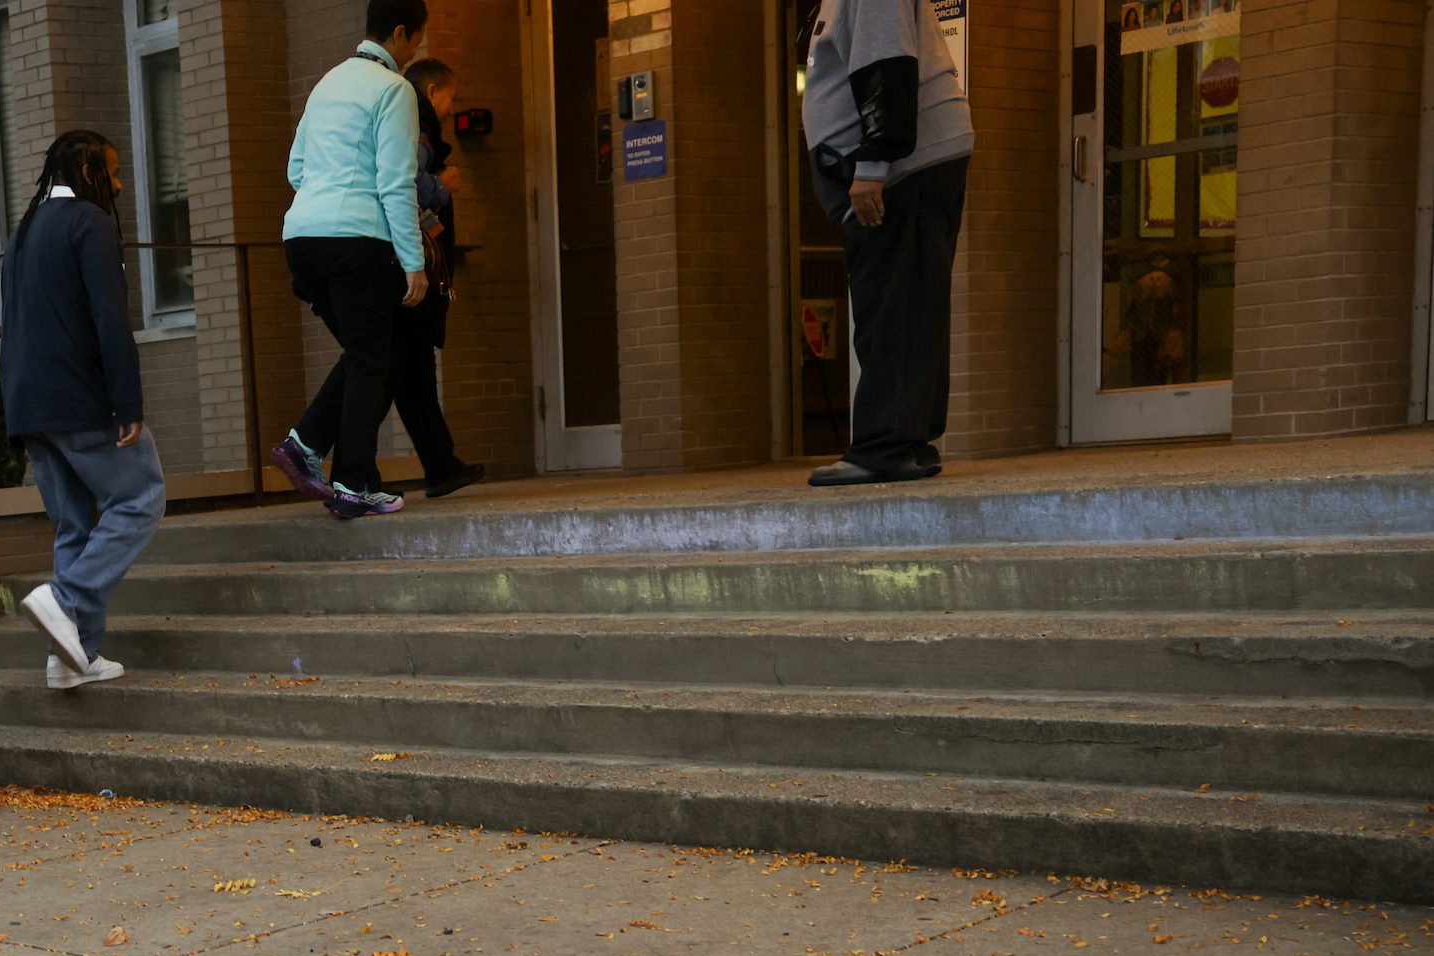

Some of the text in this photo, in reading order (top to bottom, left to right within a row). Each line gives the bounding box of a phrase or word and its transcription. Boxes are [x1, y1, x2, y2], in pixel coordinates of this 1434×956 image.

[626, 134, 663, 148] INTERCOM
[635, 150, 650, 158] ENTER
[627, 156, 663, 167] PRESS BUTTON
